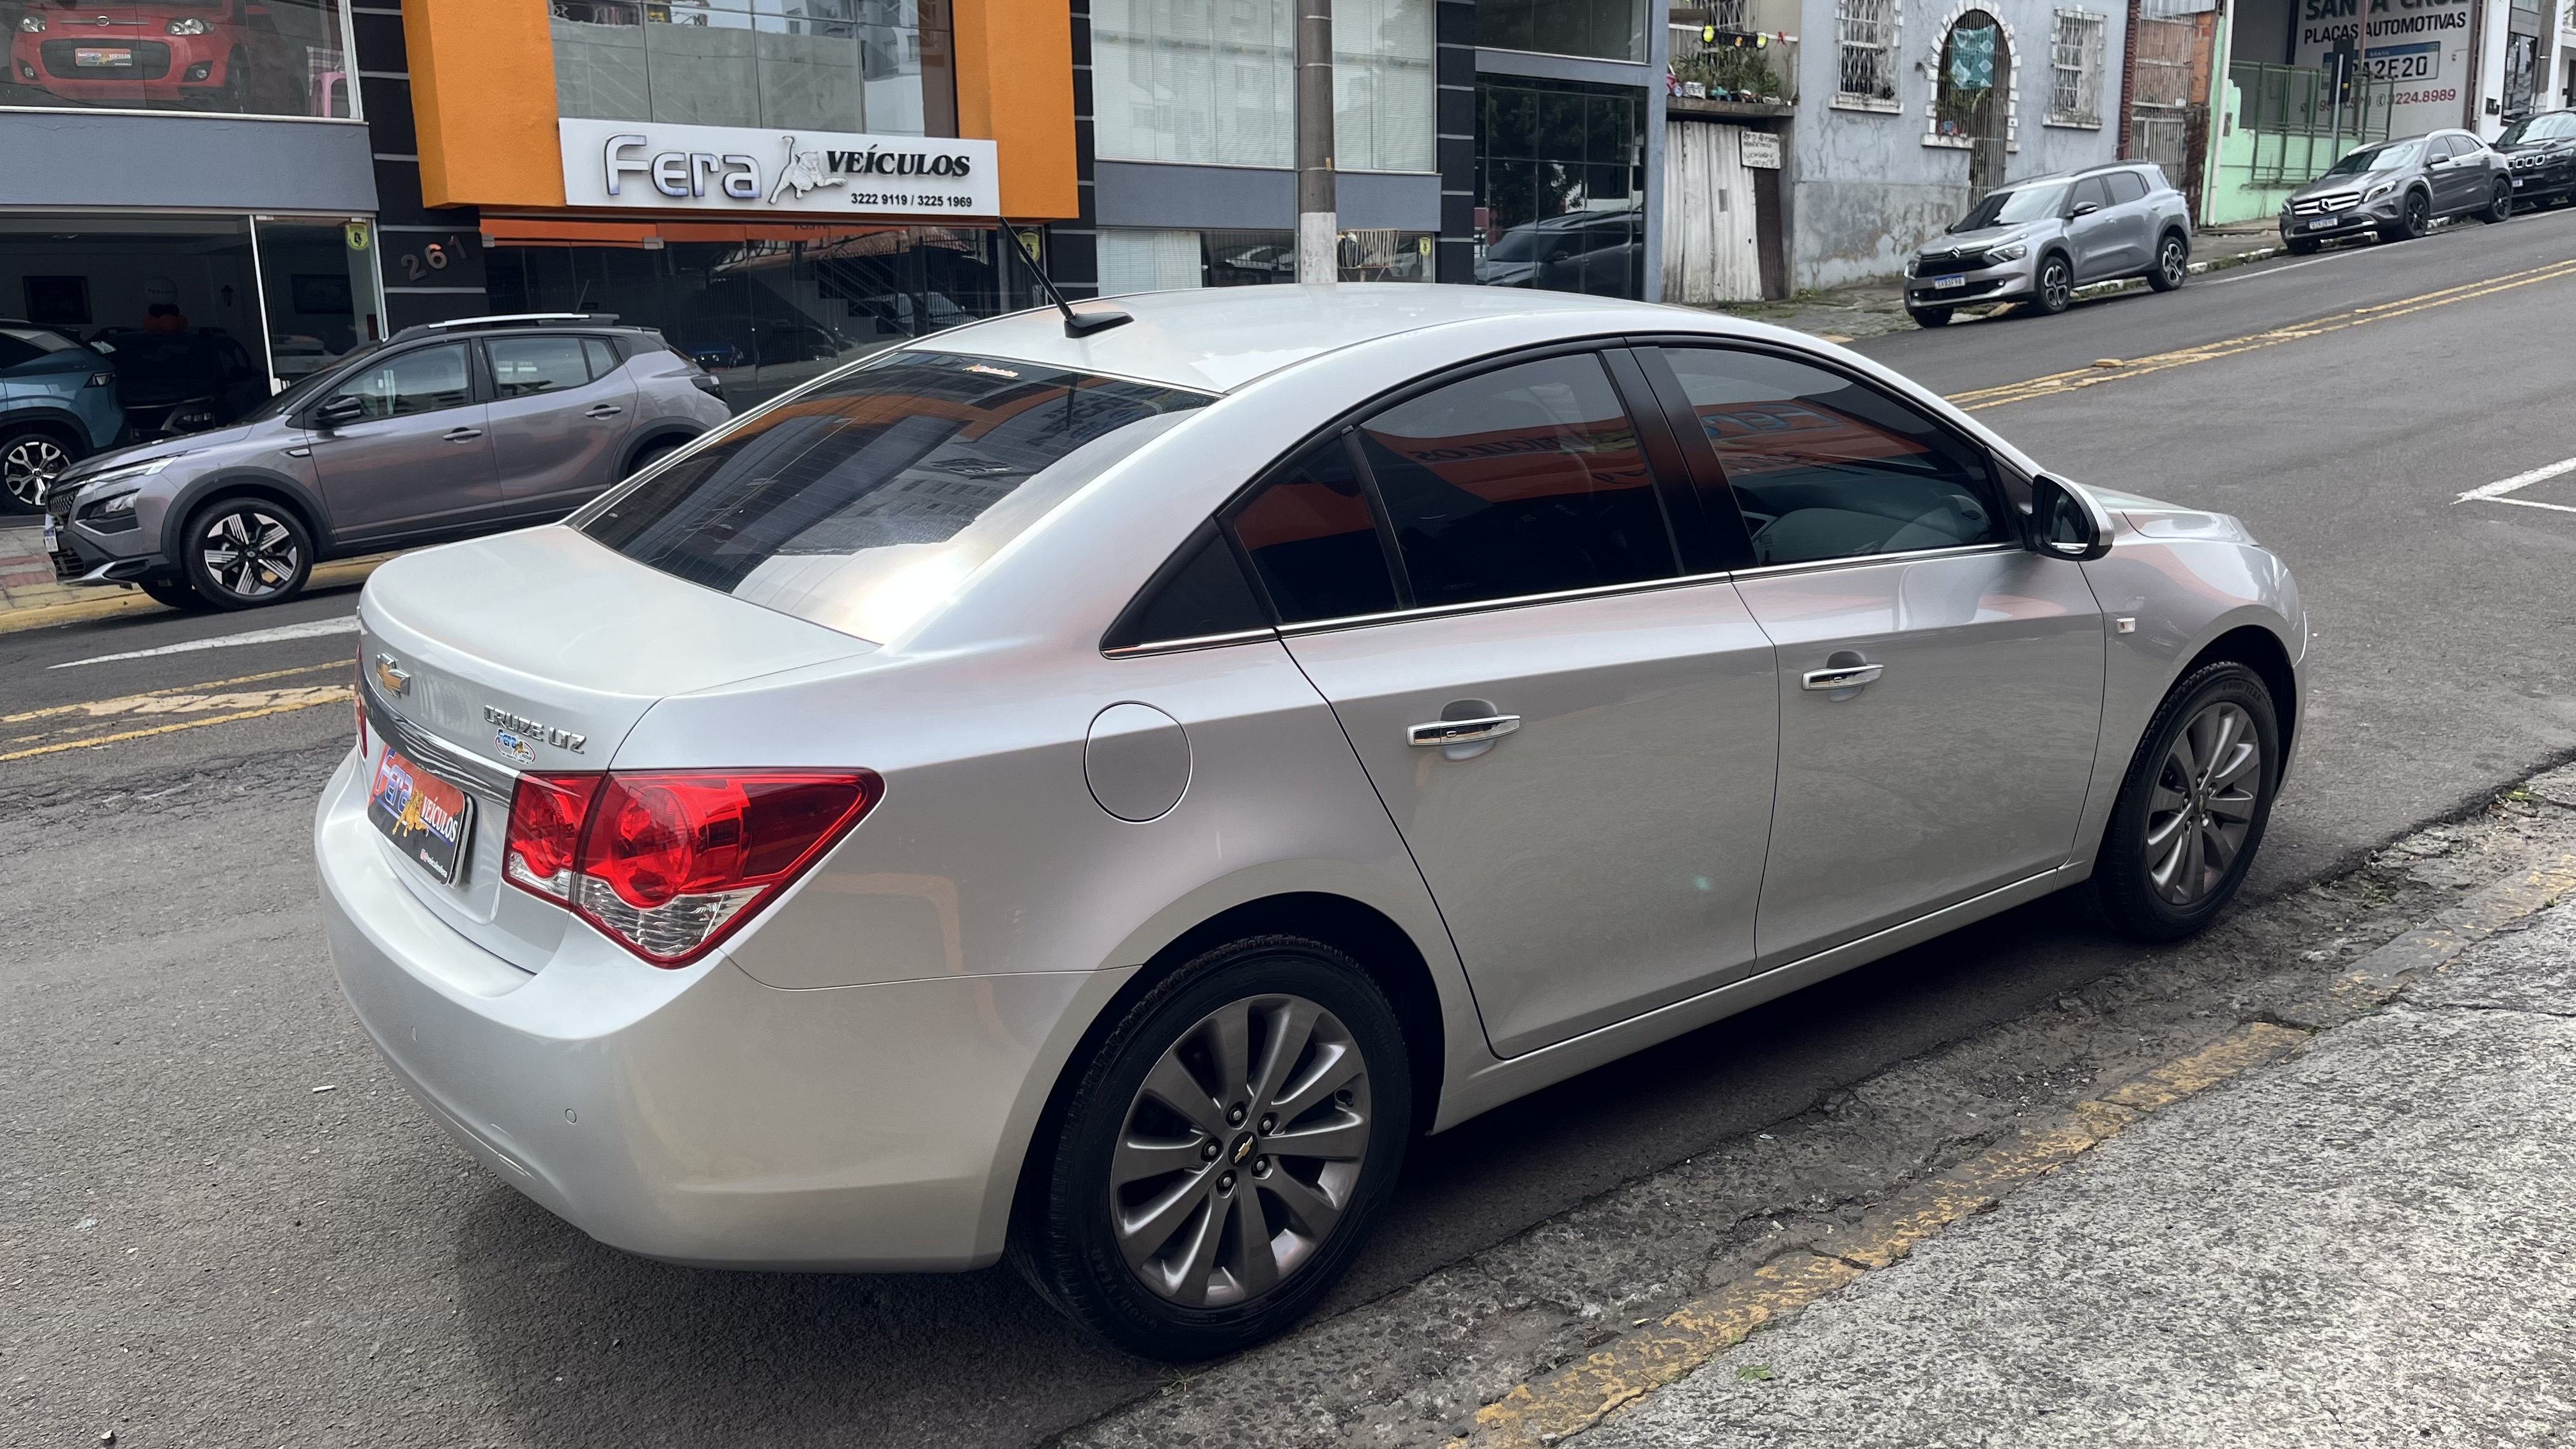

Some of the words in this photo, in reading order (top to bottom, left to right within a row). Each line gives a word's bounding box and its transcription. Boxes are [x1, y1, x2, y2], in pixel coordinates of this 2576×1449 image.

[2304, 23, 2359, 44] PLACAS
[2365, 12, 2467, 37] AUTOMOTIVAS
[2306, 0, 2391, 21] SANA
[604, 134, 762, 199] Fera
[827, 144, 970, 177] VEÍCULOS
[851, 193, 878, 204] 3222
[882, 194, 908, 205] 9119
[917, 195, 944, 206] 3225
[947, 196, 972, 207] 1969
[401, 235, 467, 281] 261
[484, 705, 544, 742] CRUZE
[549, 727, 586, 755] LTZ
[421, 796, 458, 843] VEÍCULOS
